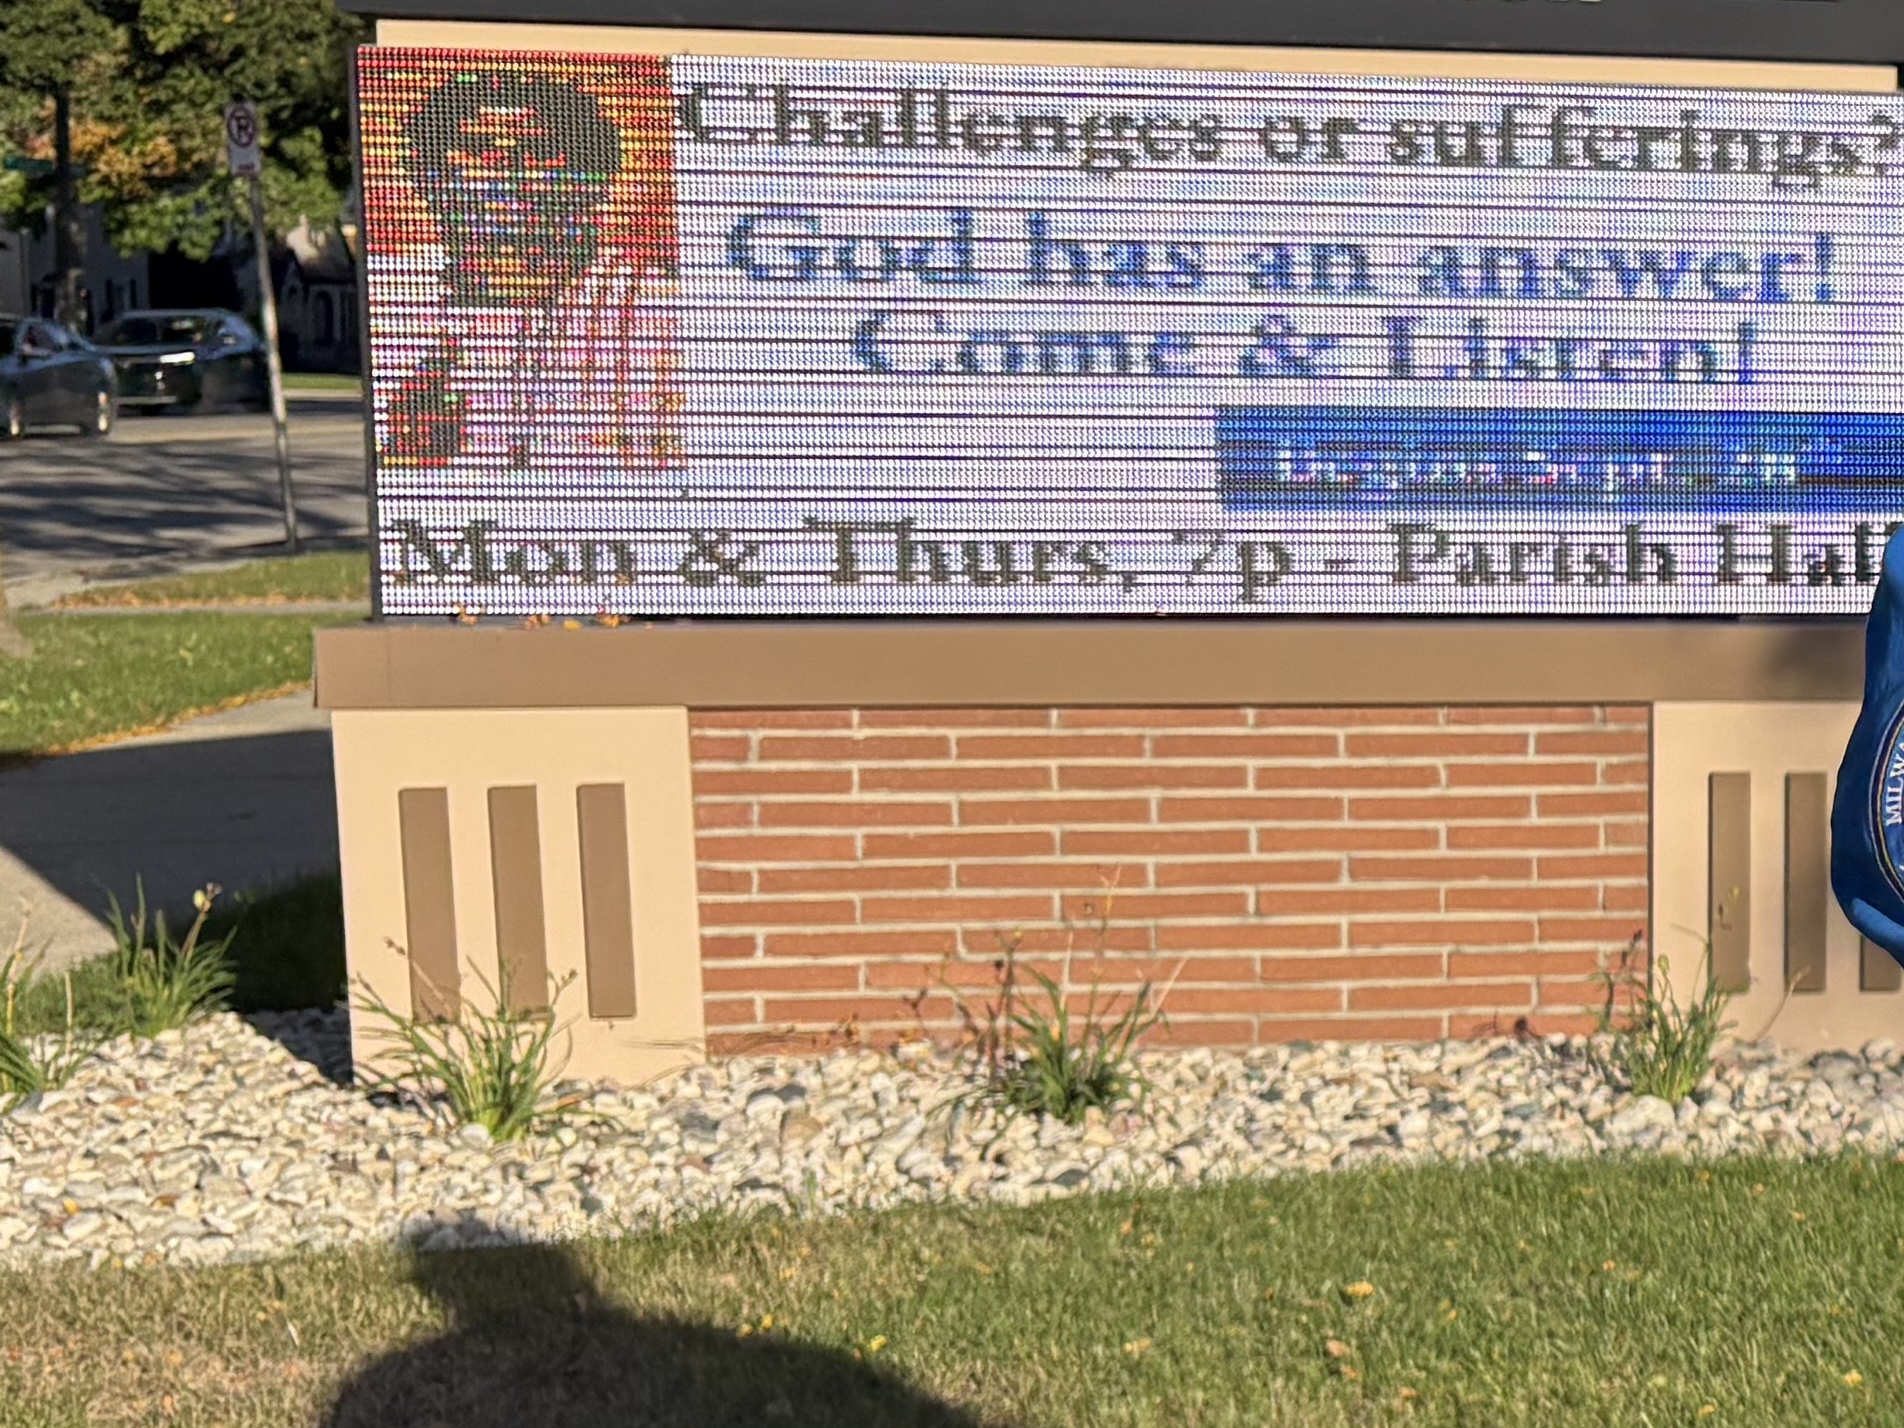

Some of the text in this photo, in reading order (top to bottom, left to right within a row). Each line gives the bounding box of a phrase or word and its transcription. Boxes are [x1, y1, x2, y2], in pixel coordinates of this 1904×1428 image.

[679, 78, 1900, 193] Challenges or sufferings?
[726, 207, 1836, 305] God has an answer!
[850, 309, 1758, 387] Come & Listen!
[391, 518, 638, 587] Mon
[676, 528, 766, 587] &
[803, 516, 1139, 593] Thurs,
[1170, 528, 1294, 604] 7p
[1386, 520, 1677, 588] Parish
[1715, 521, 1903, 587] Hal
